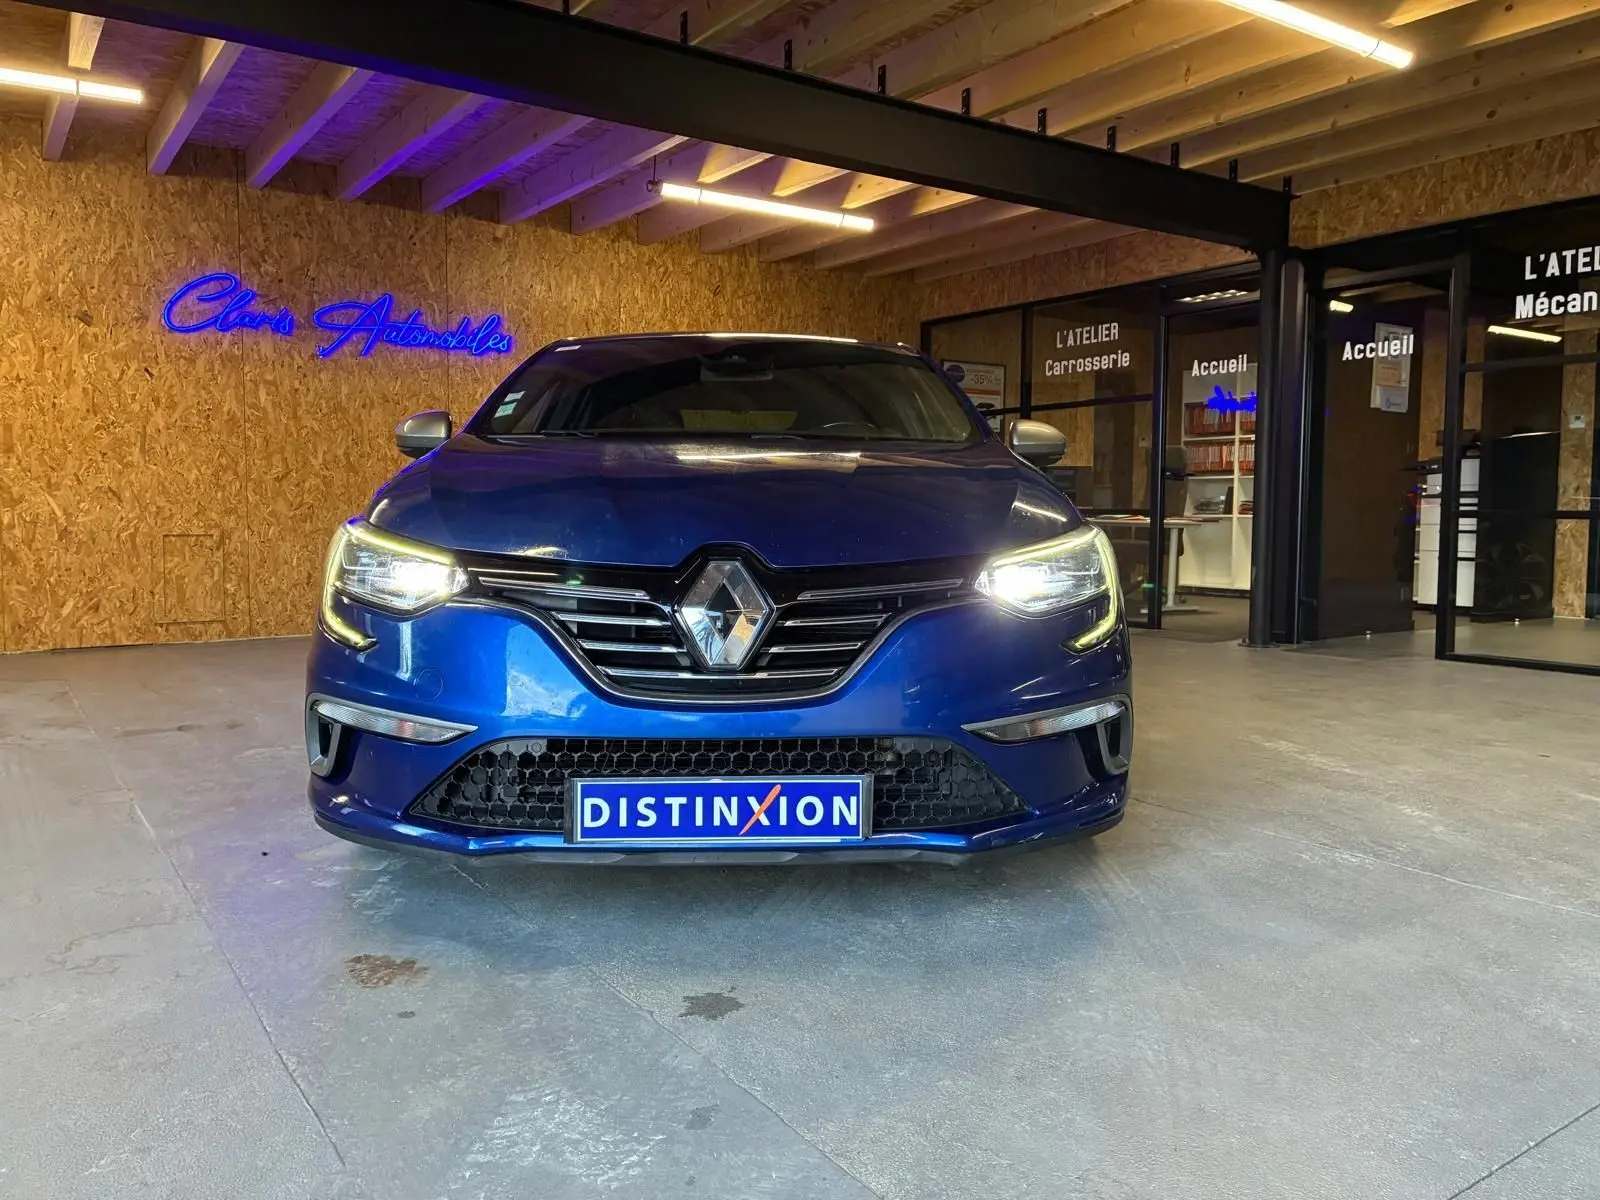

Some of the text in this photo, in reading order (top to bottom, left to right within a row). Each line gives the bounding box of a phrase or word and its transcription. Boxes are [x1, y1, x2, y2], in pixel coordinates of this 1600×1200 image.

[163, 272, 514, 358] Claris Automobiles
[1056, 322, 1119, 349] L'ATELIER
[1342, 334, 1414, 361] Accueil
[1045, 349, 1130, 376] Carrosserie
[1191, 353, 1248, 377] Accueil
[583, 784, 857, 836] DISTINXION
